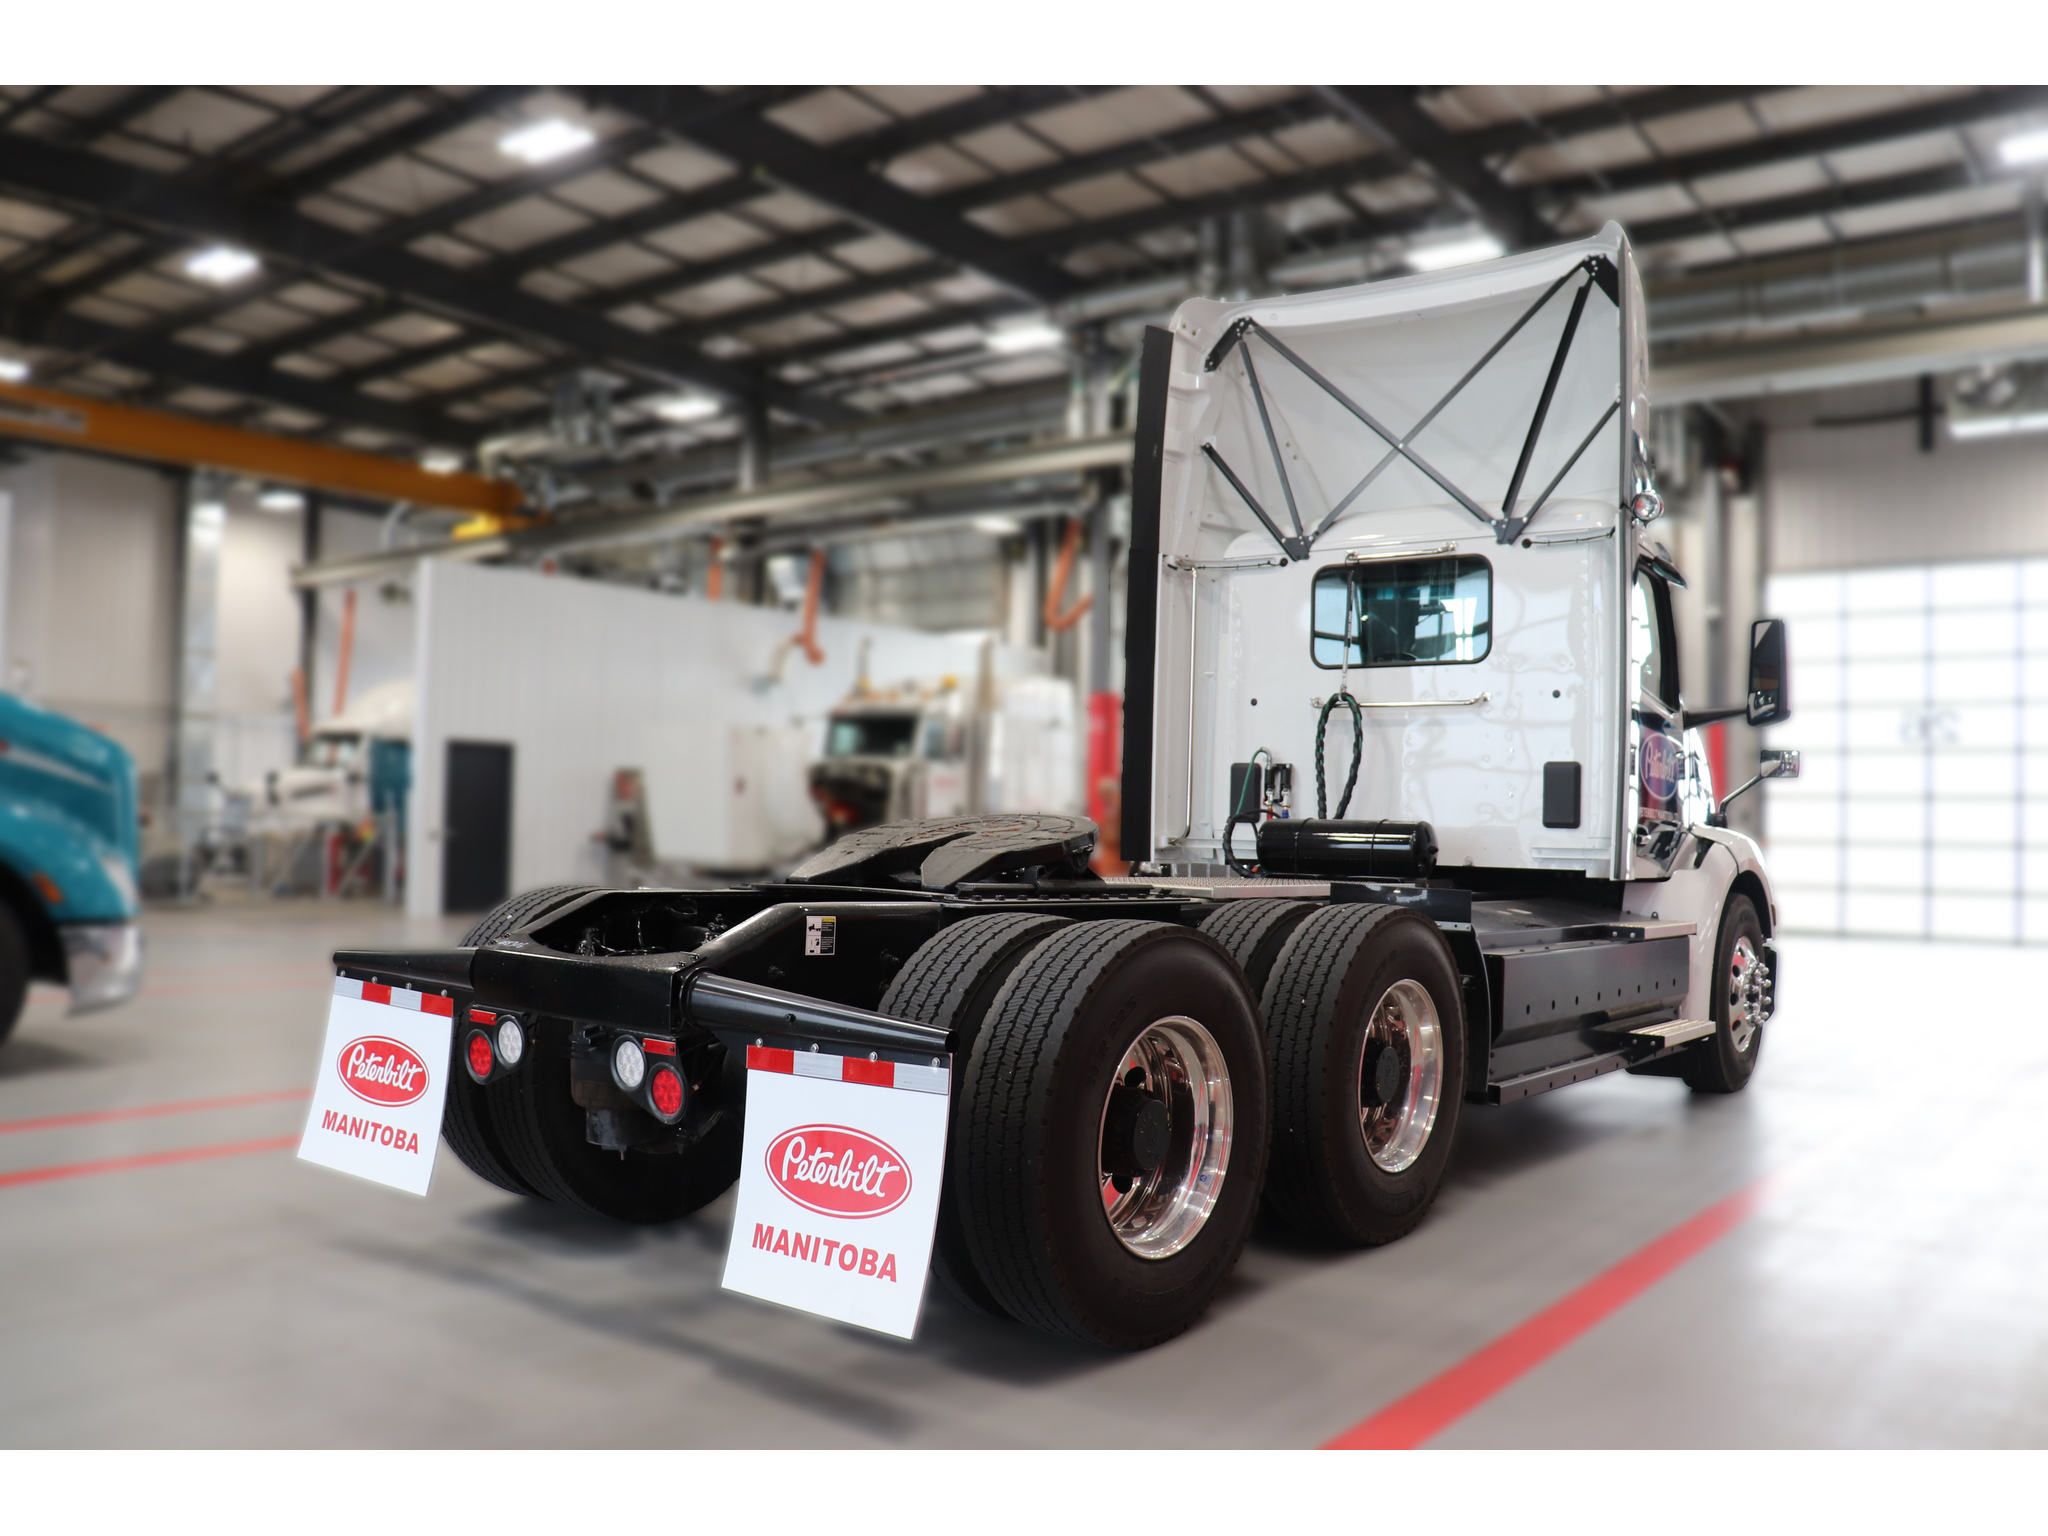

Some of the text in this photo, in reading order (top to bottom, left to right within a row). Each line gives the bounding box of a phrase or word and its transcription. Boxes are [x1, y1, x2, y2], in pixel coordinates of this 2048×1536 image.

[347, 1044, 424, 1092] Peterbilt
[321, 1109, 419, 1155] MANITOBA
[782, 1136, 900, 1197] Peterbilt
[751, 1222, 897, 1282] MANITOBA
